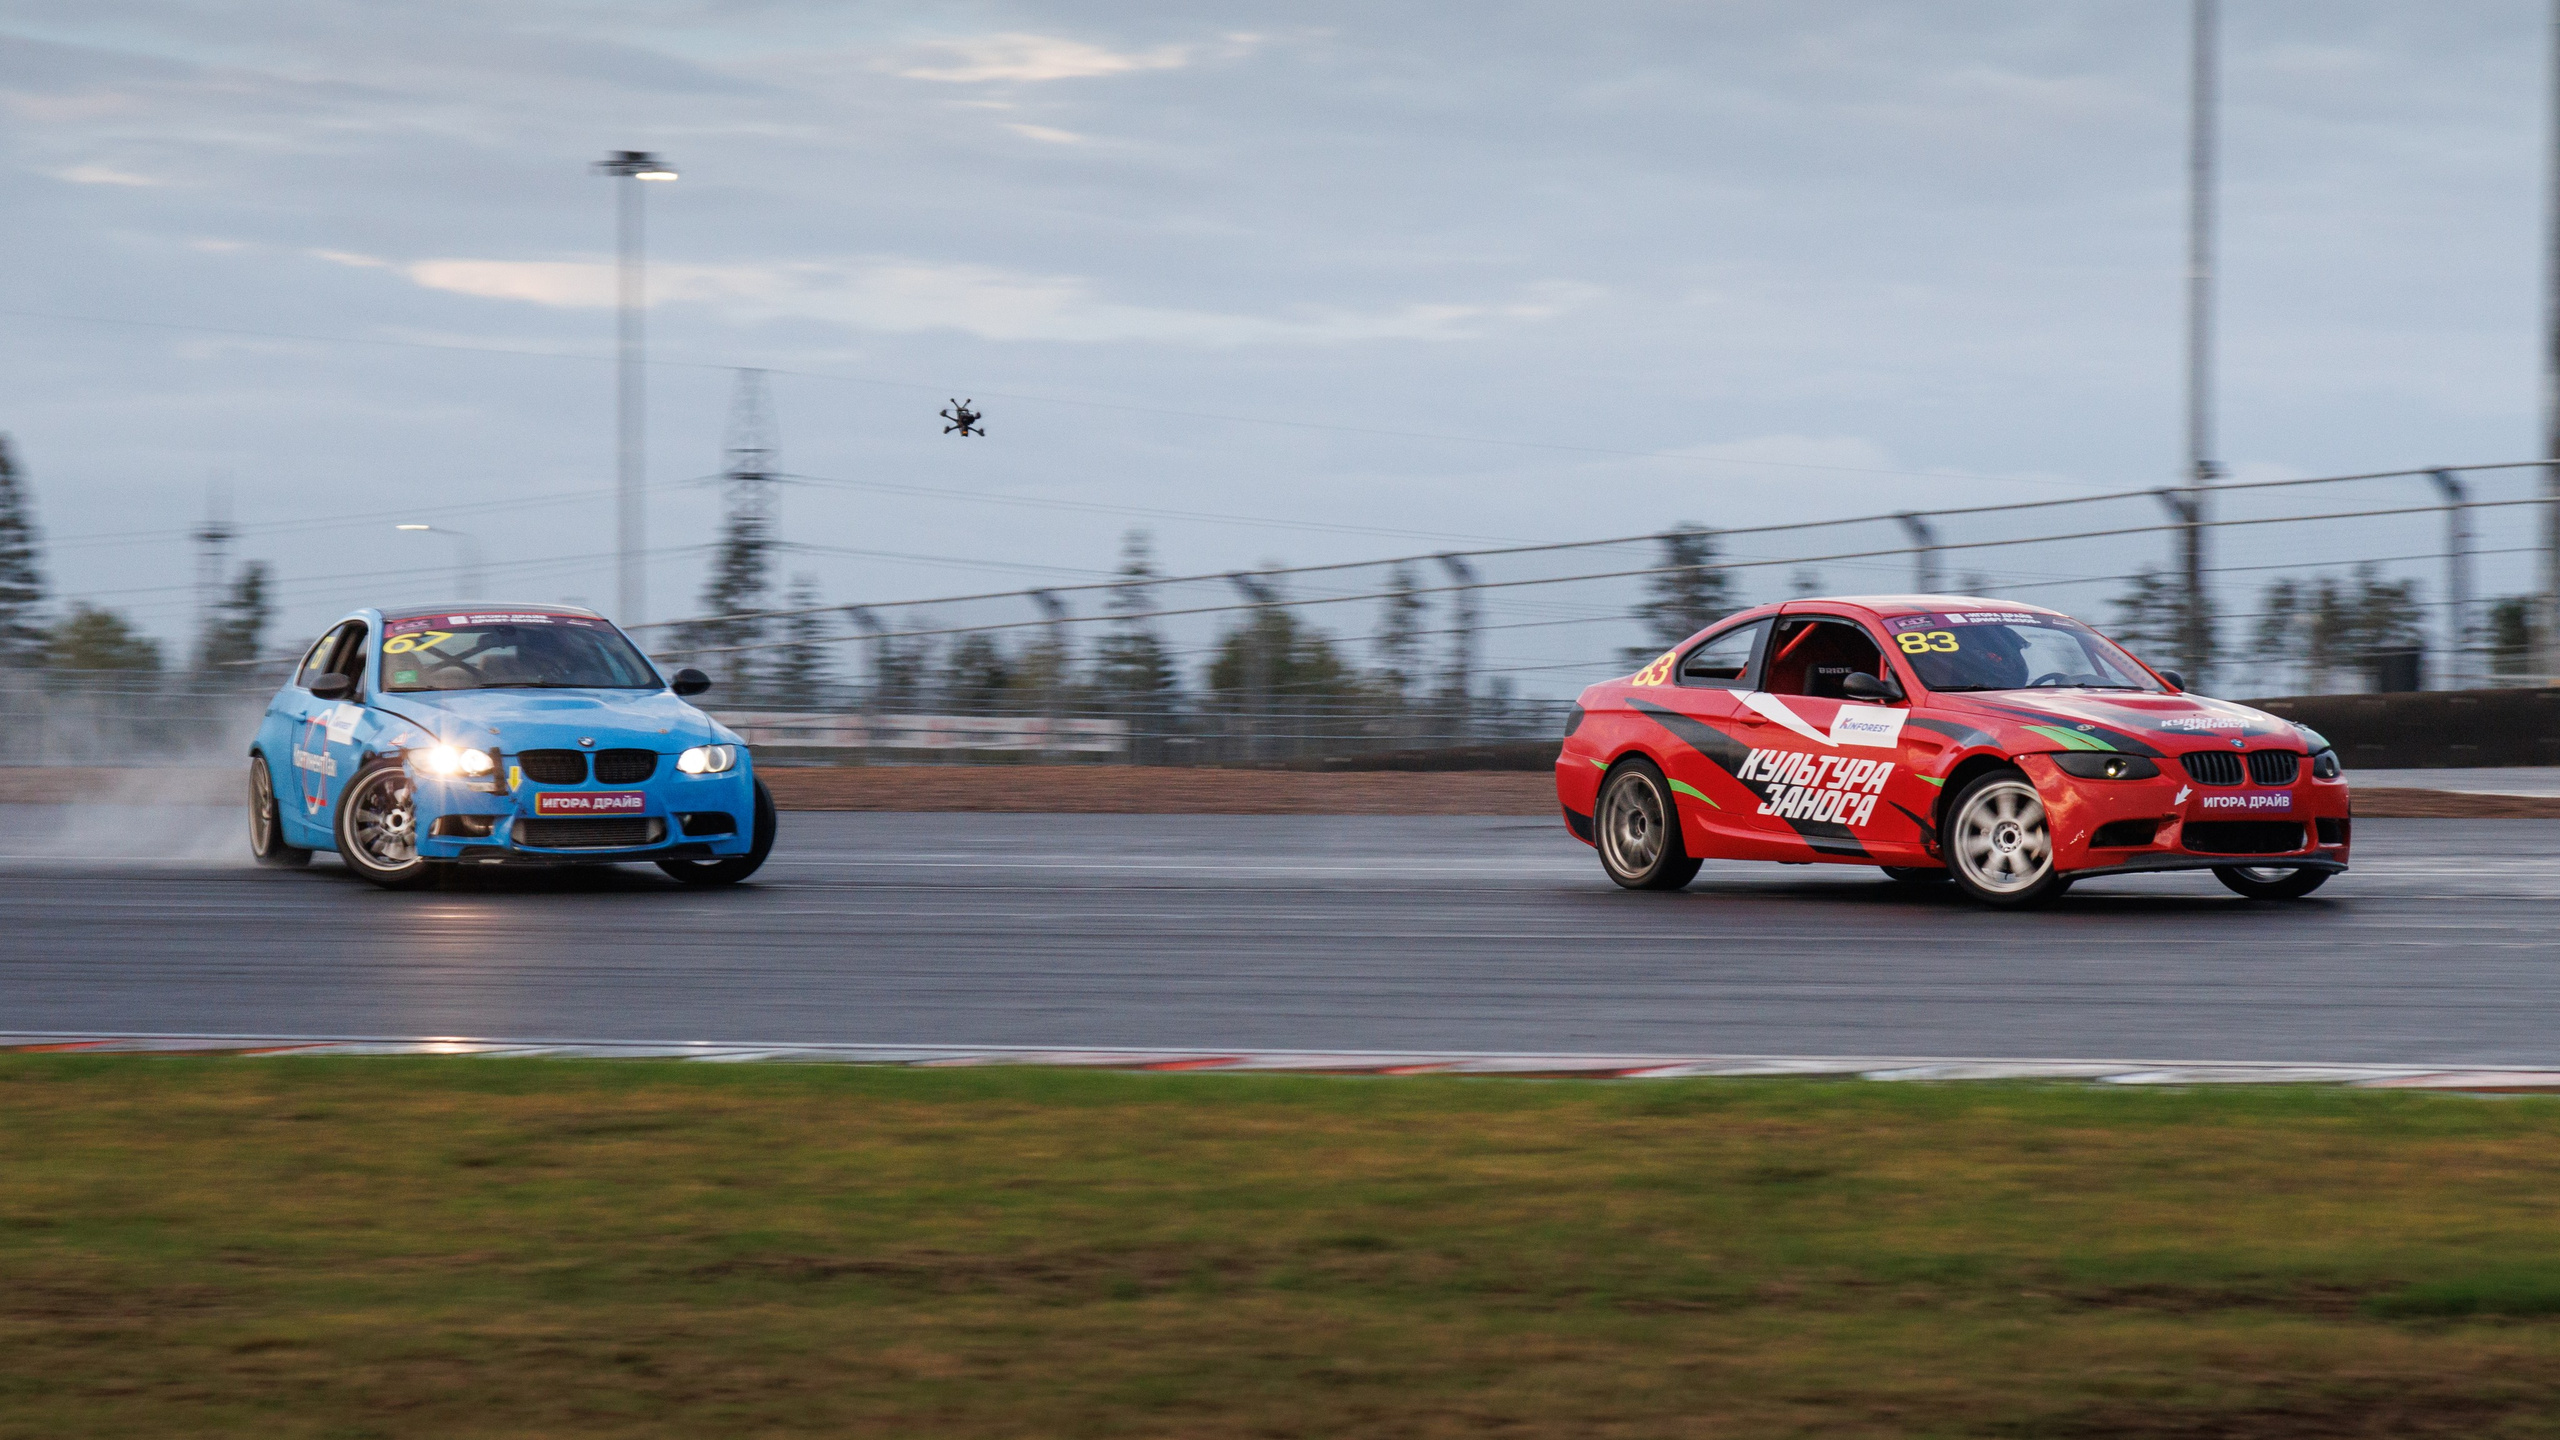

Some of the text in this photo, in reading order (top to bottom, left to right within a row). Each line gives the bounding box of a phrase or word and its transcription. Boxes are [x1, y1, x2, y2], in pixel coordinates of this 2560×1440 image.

[382, 630, 454, 654] 67
[1896, 631, 1960, 654] 83
[1632, 651, 1677, 687] 83
[1838, 717, 1890, 733] KINFOREST
[1736, 748, 1896, 795] КУЛЬТУРА
[542, 794, 643, 810] ИГОРА ДРАЙВ
[1757, 783, 1878, 827] ЗАНОСА
[2203, 793, 2290, 809] ИГОРА ДРАЙВ
